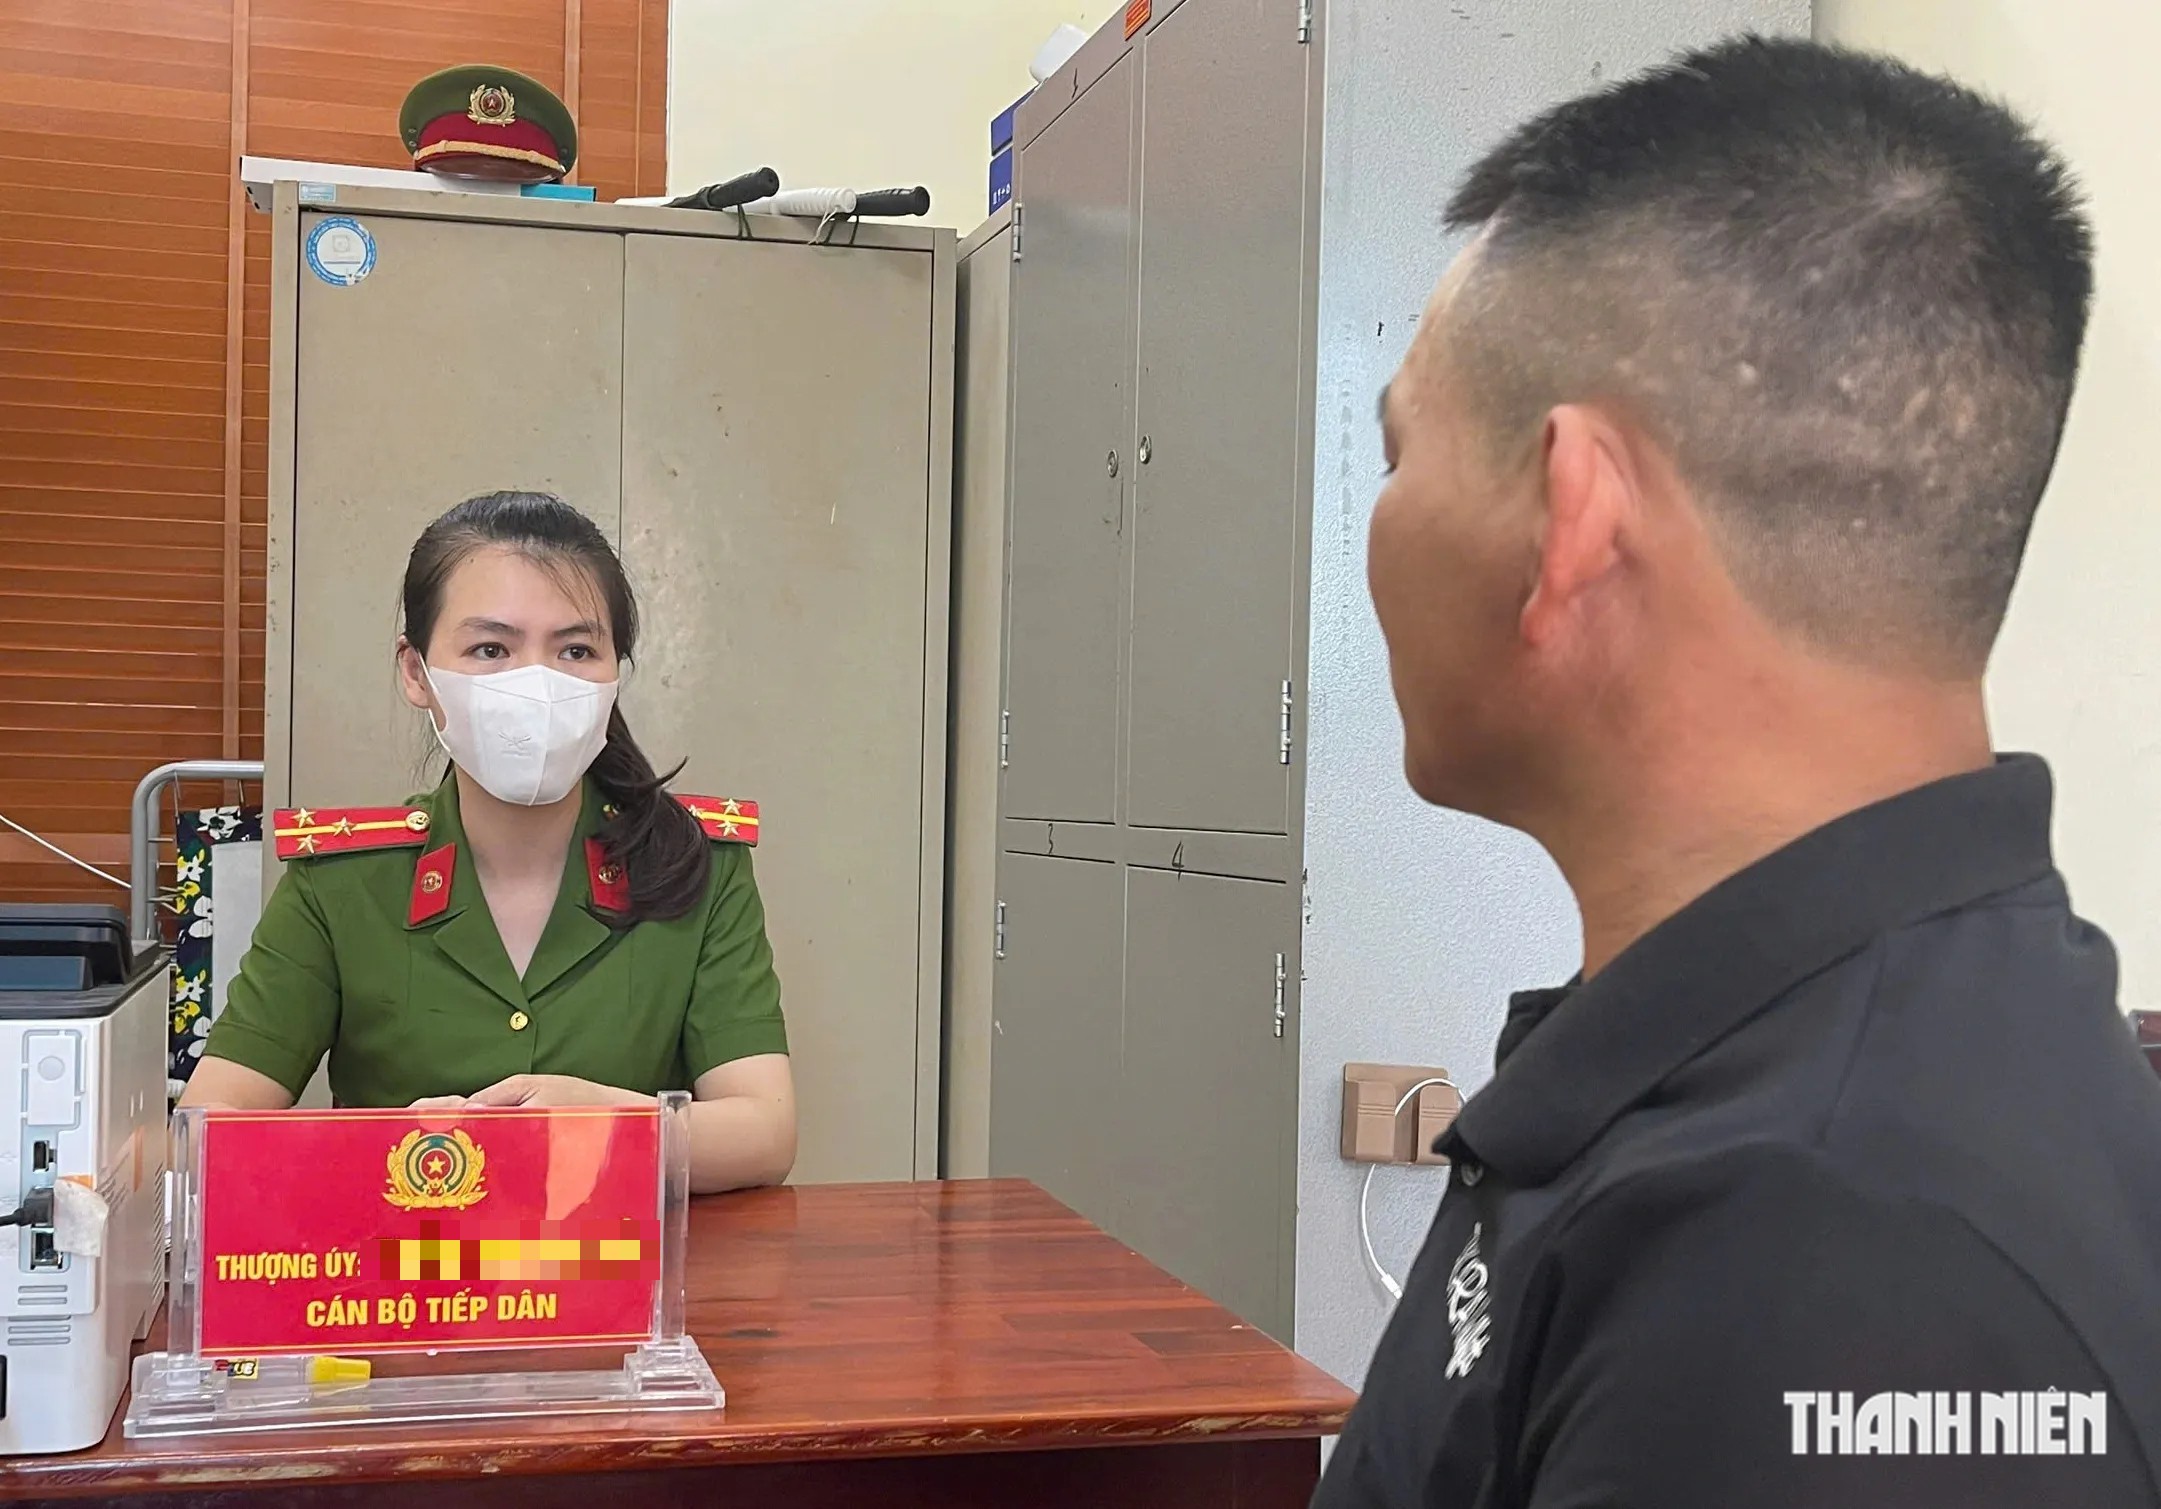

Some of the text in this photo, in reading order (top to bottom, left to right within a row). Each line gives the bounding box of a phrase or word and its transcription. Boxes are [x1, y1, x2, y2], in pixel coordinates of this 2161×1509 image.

[1171, 840, 1185, 882] 4
[215, 1251, 318, 1286] THƯỢNG
[306, 1287, 557, 1329] CÁN BỘ TIẾP DÂN
